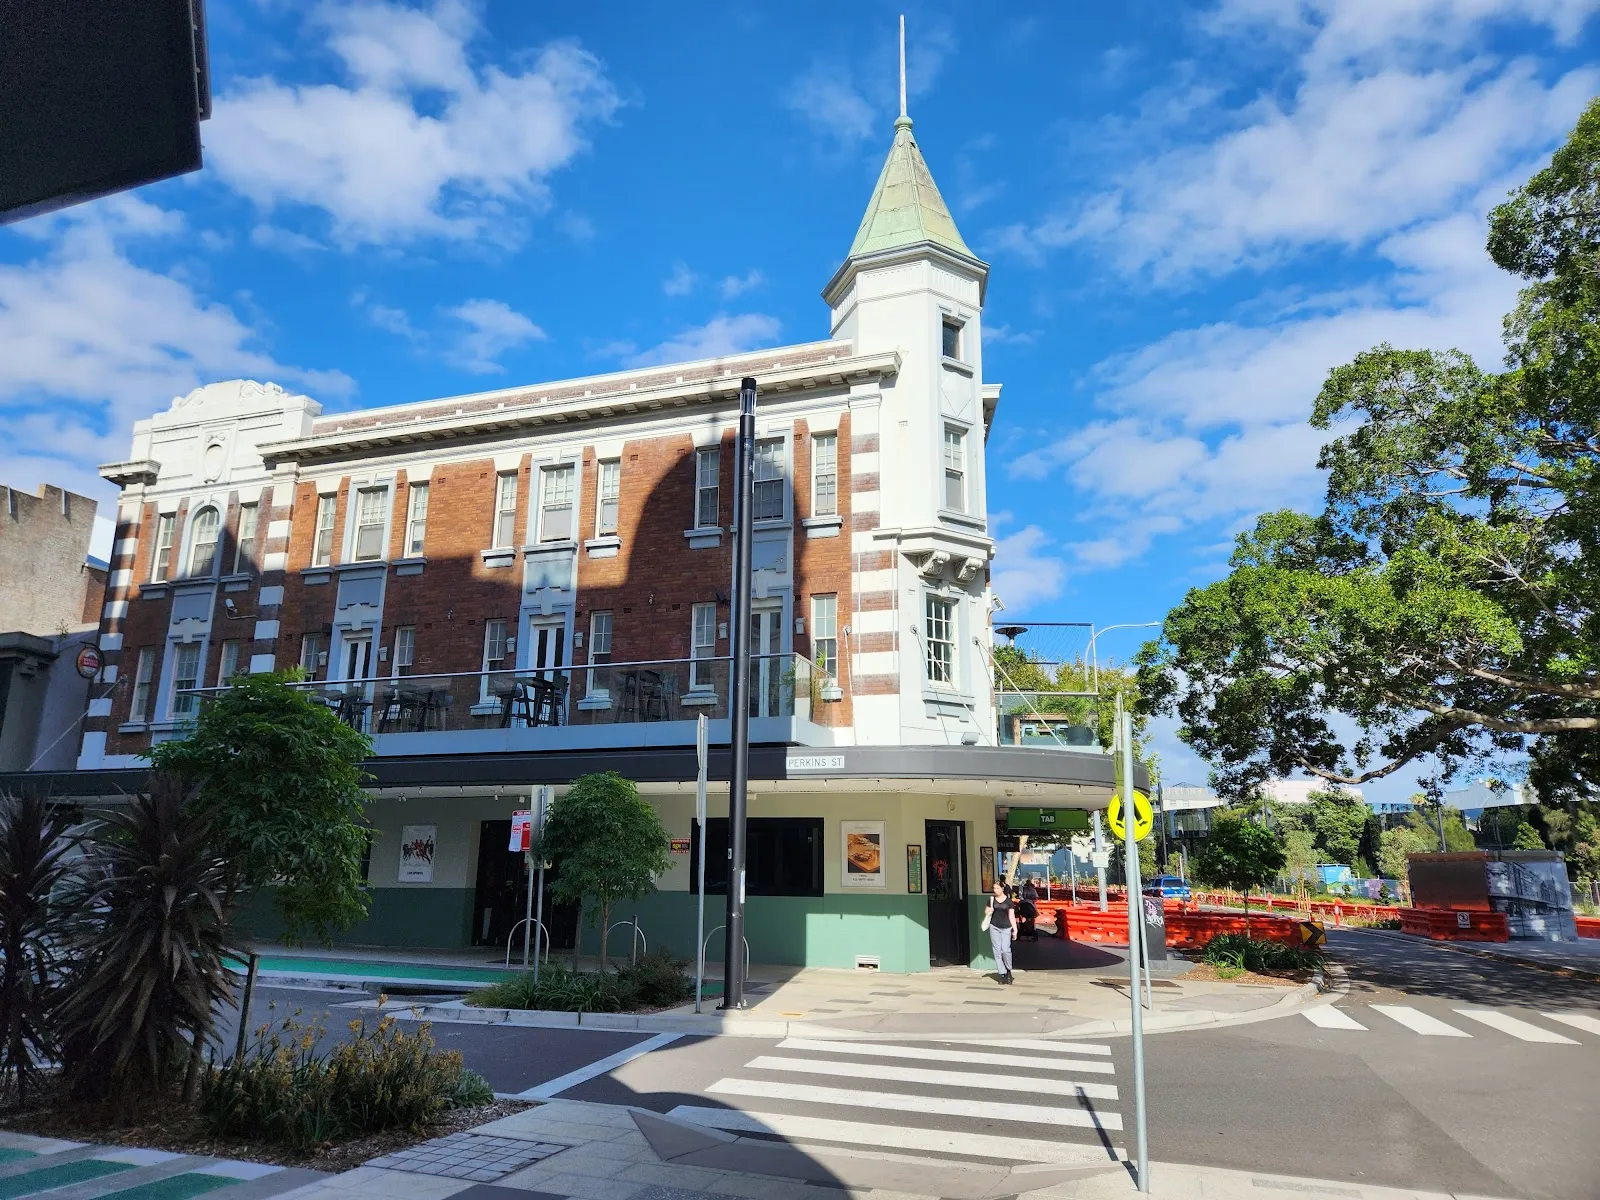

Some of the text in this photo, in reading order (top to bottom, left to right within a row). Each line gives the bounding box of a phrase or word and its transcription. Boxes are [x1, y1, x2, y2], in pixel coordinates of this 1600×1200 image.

[788, 757, 842, 768] PERKINS ST
[1040, 815, 1055, 823] TAB
